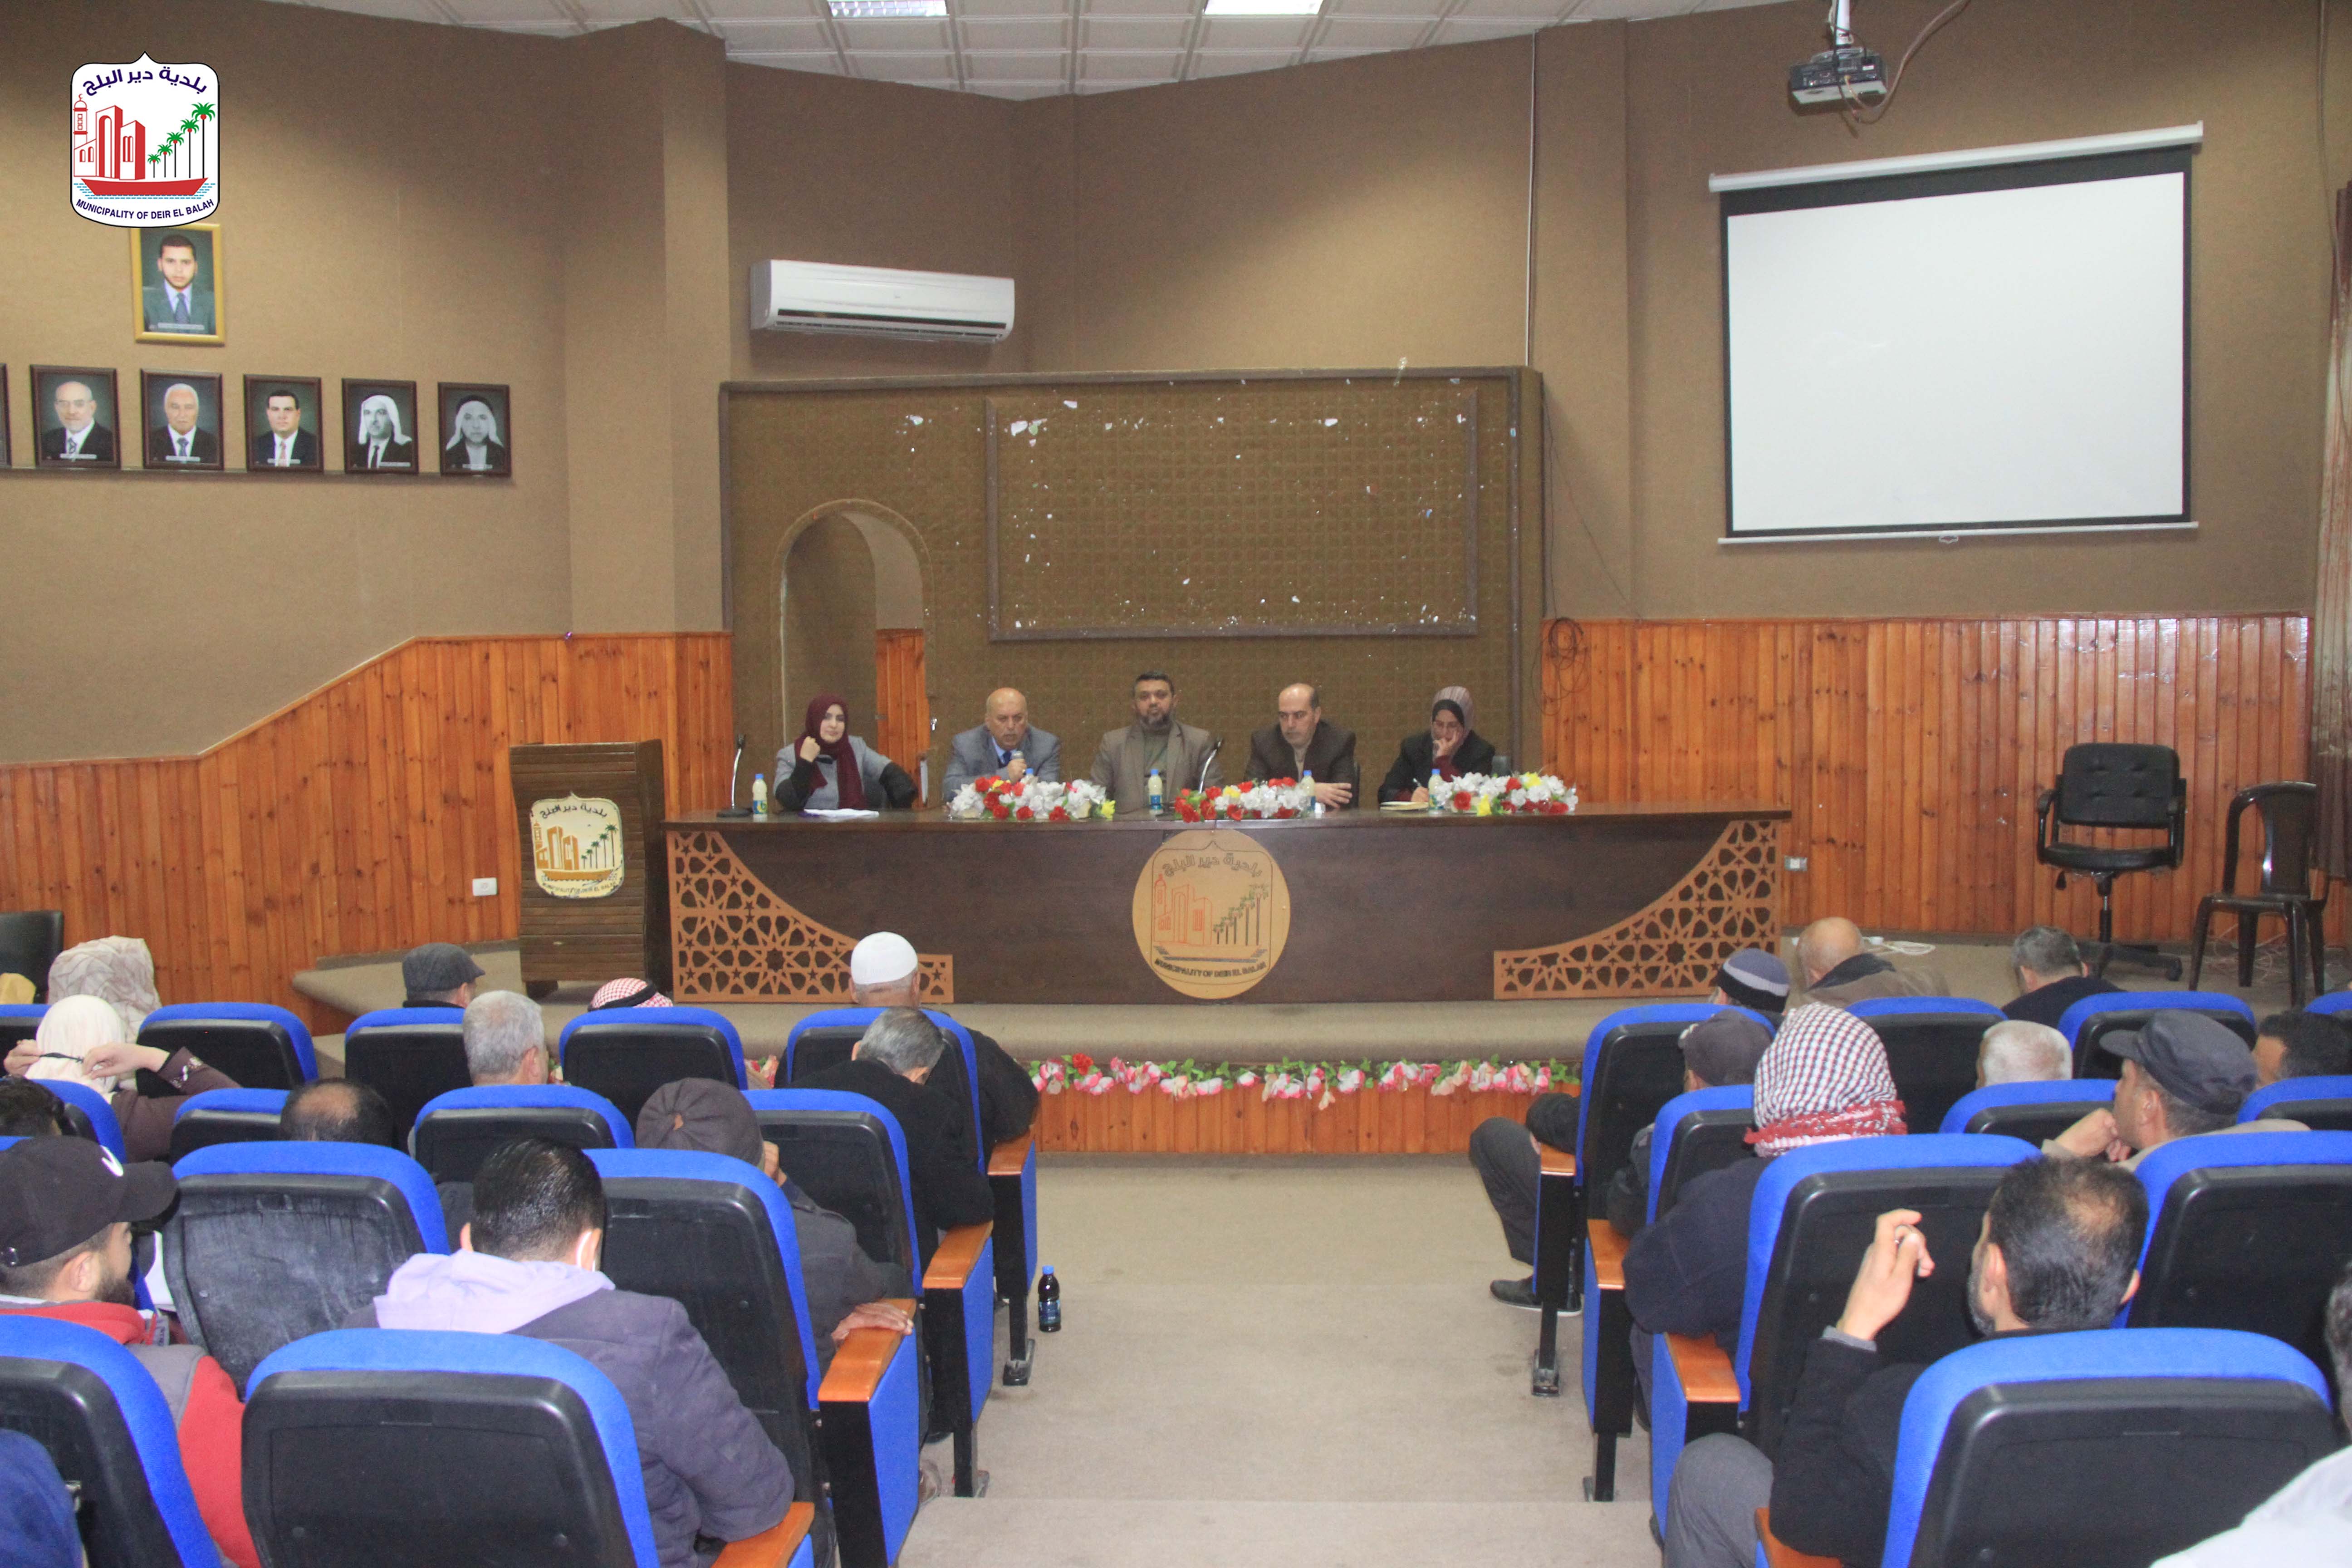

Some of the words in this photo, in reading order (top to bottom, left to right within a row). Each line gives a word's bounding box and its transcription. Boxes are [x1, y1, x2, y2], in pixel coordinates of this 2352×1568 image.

[1162, 854, 1196, 877] البلح
[1198, 856, 1220, 868] دير
[1223, 852, 1263, 877] بلدية
